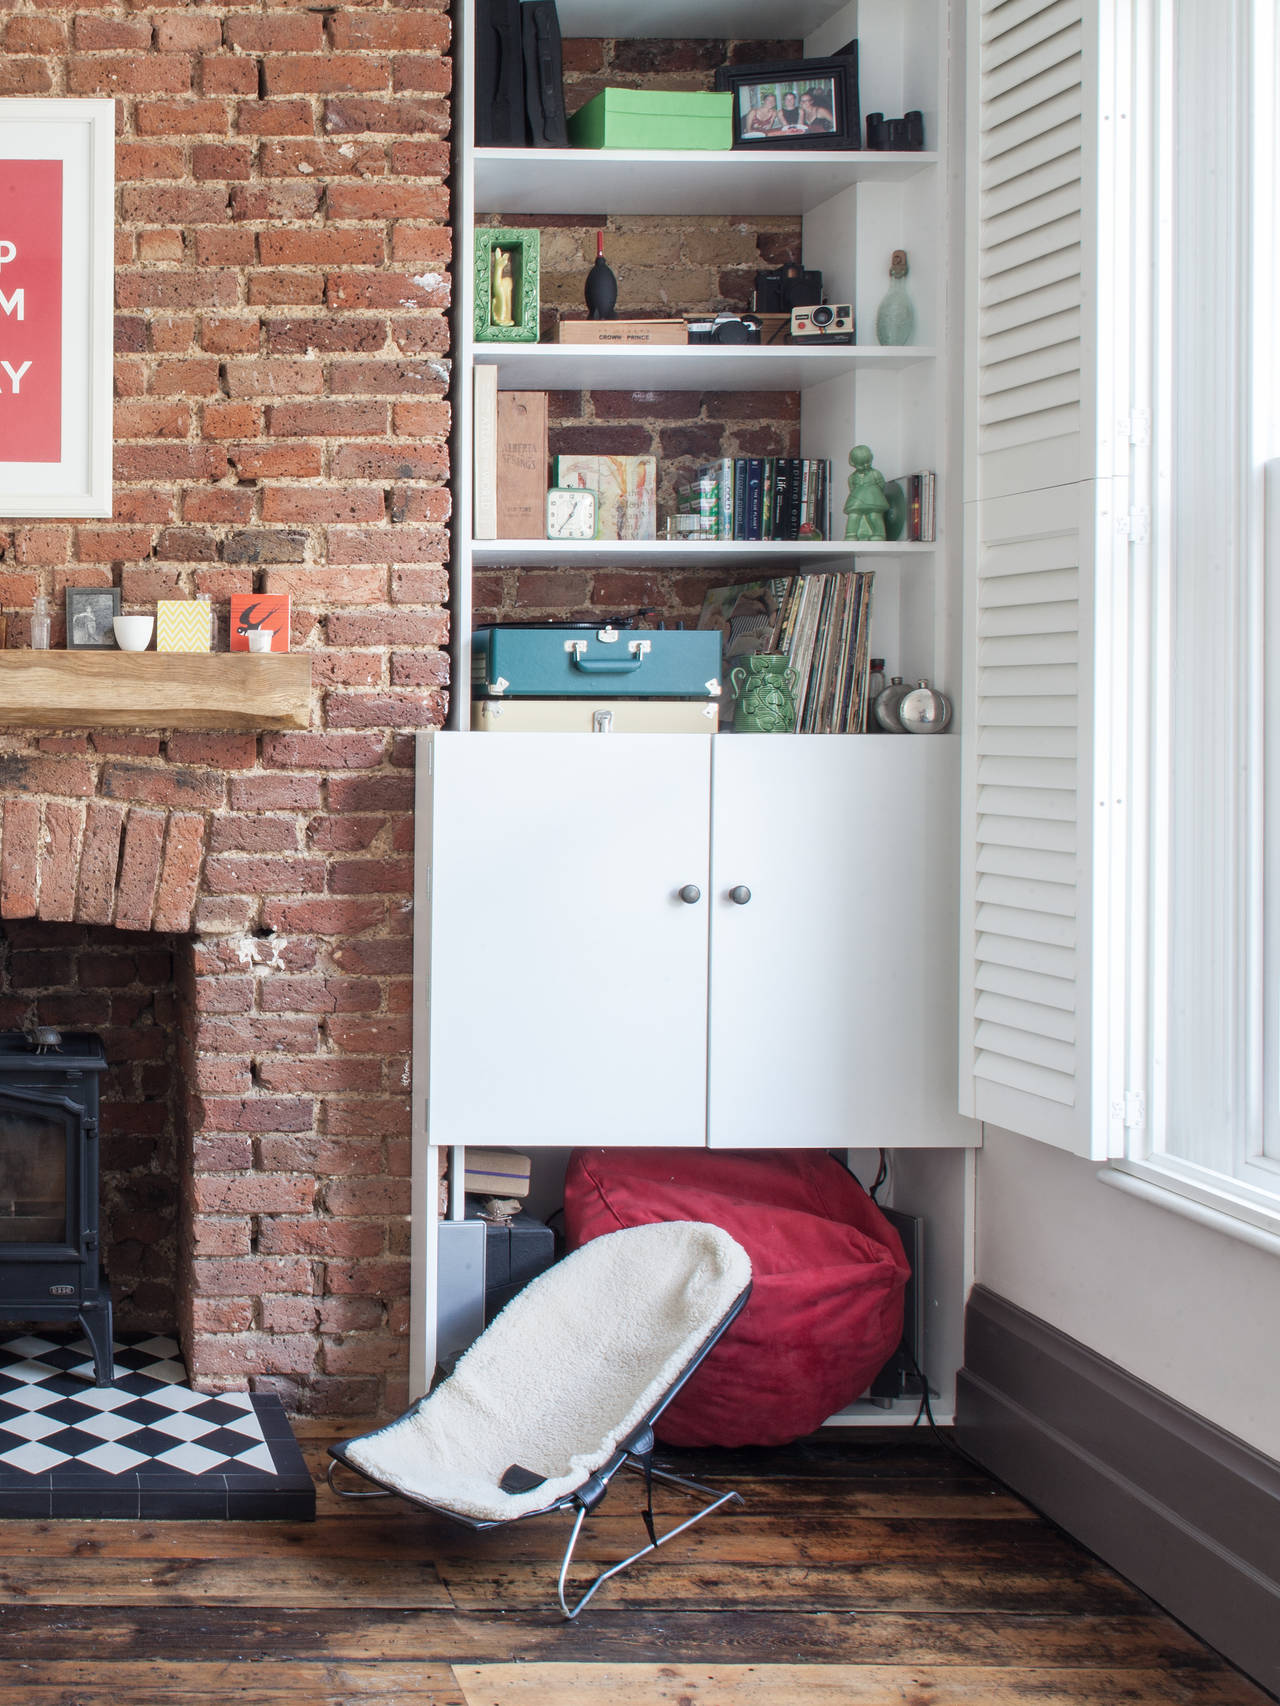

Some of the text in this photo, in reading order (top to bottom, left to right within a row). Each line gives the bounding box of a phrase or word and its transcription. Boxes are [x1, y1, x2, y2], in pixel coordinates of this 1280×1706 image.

[598, 333, 650, 342] CROWN PRINCE
[503, 443, 538, 455] ALBERTA
[776, 476, 787, 493] Life
[791, 469, 801, 539] planet earth
